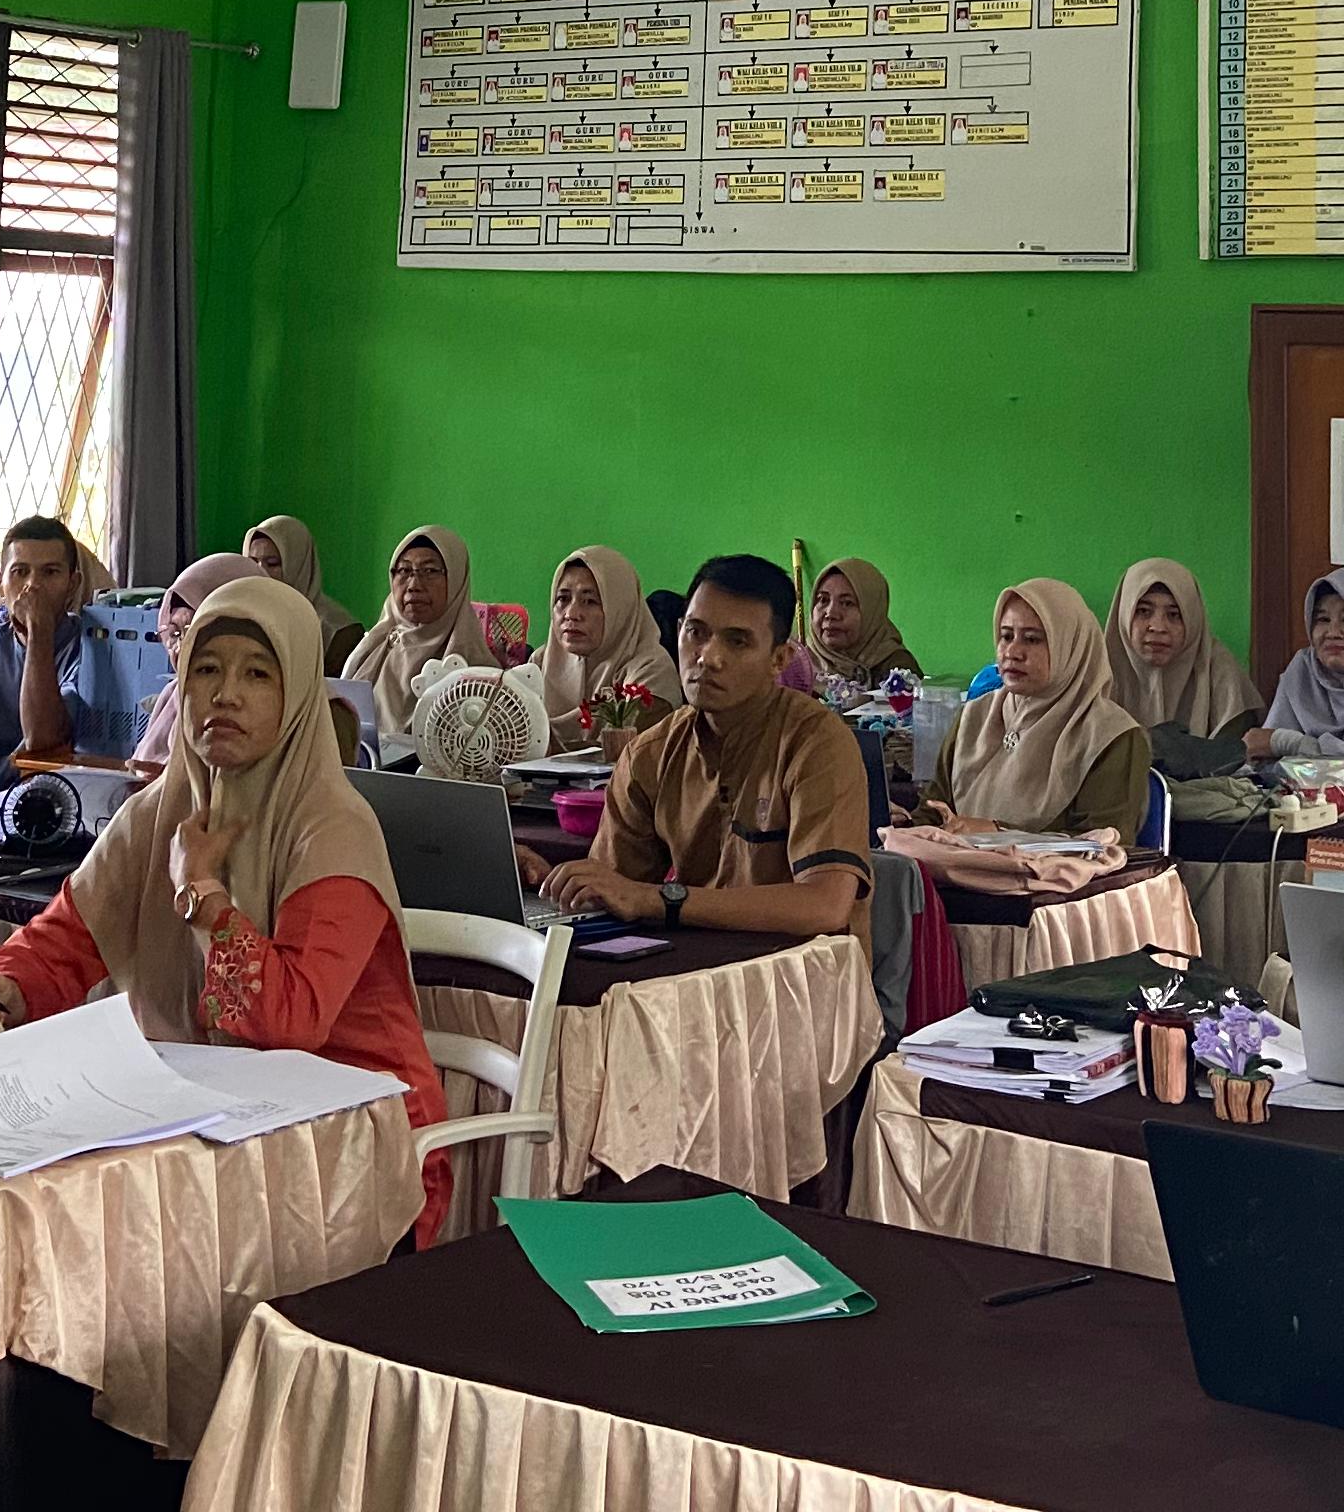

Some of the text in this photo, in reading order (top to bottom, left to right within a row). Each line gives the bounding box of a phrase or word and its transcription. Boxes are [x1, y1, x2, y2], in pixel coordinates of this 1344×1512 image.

[1228, 0, 1239, 8] 10
[1228, 16, 1238, 24] 11
[1228, 31, 1239, 40] 12
[1228, 48, 1239, 56] 13
[1227, 64, 1238, 73] 14
[1227, 80, 1239, 89] 15
[1227, 96, 1239, 106] 16
[1228, 113, 1239, 122] 17
[1228, 129, 1239, 138] 18
[1228, 145, 1239, 154] 19
[1227, 162, 1240, 171] 20
[1227, 178, 1238, 187] 21
[1227, 195, 1239, 204] 22
[1227, 211, 1239, 220] 23
[683, 226, 715, 235] SISWA
[1226, 228, 1238, 237] 24
[1226, 244, 1238, 253] 25
[648, 1287, 776, 1311] RUANG IV
